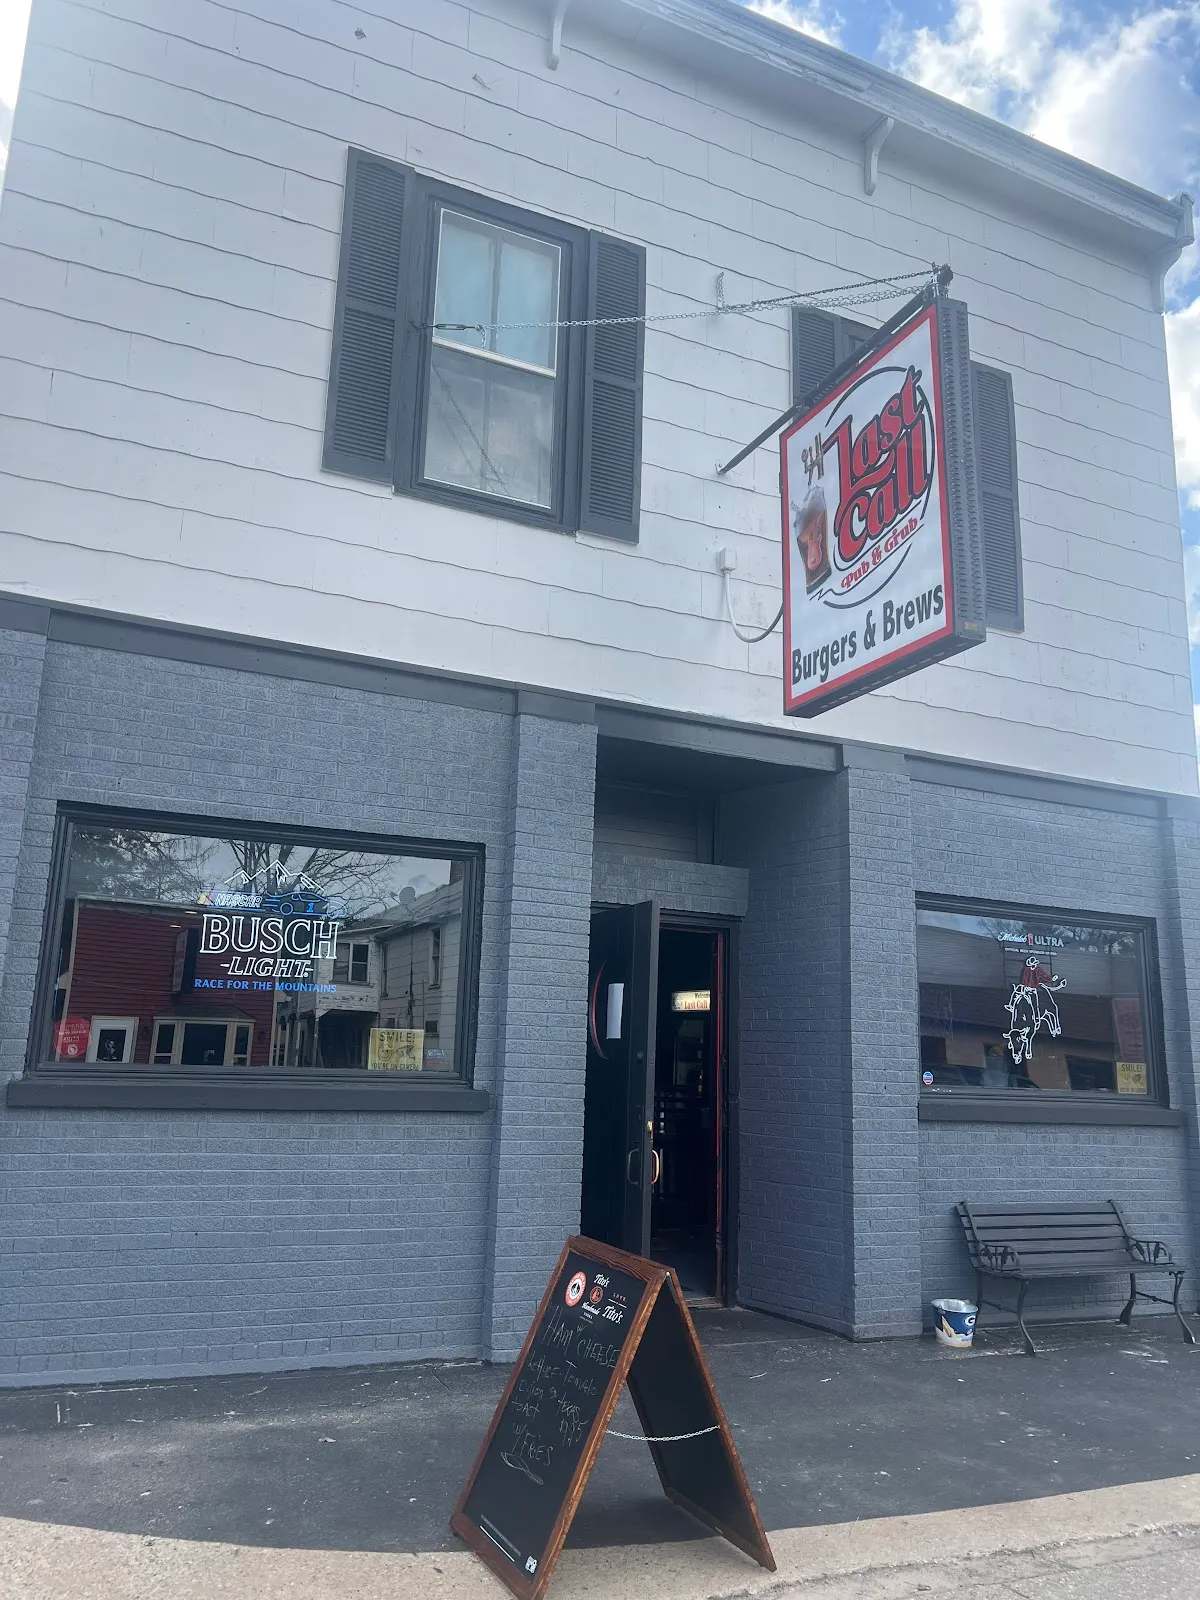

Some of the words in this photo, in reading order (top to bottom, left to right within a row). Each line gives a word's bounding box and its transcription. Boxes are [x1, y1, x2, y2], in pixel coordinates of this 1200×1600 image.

[841, 561, 870, 589] Pub
[871, 545, 883, 566] &
[884, 517, 919, 553] Grub
[791, 629, 857, 686] Burgers
[863, 609, 877, 650] &
[882, 584, 944, 642] Brews
[200, 914, 340, 960] BUSCH
[1034, 935, 1064, 948] ULTRA
[194, 978, 224, 989] RACE
[226, 980, 249, 990] FOR
[252, 981, 273, 991] THE
[275, 982, 337, 993] MOUNTAINS
[593, 1273, 610, 1288] Tito's
[577, 1339, 621, 1368] CHEESE
